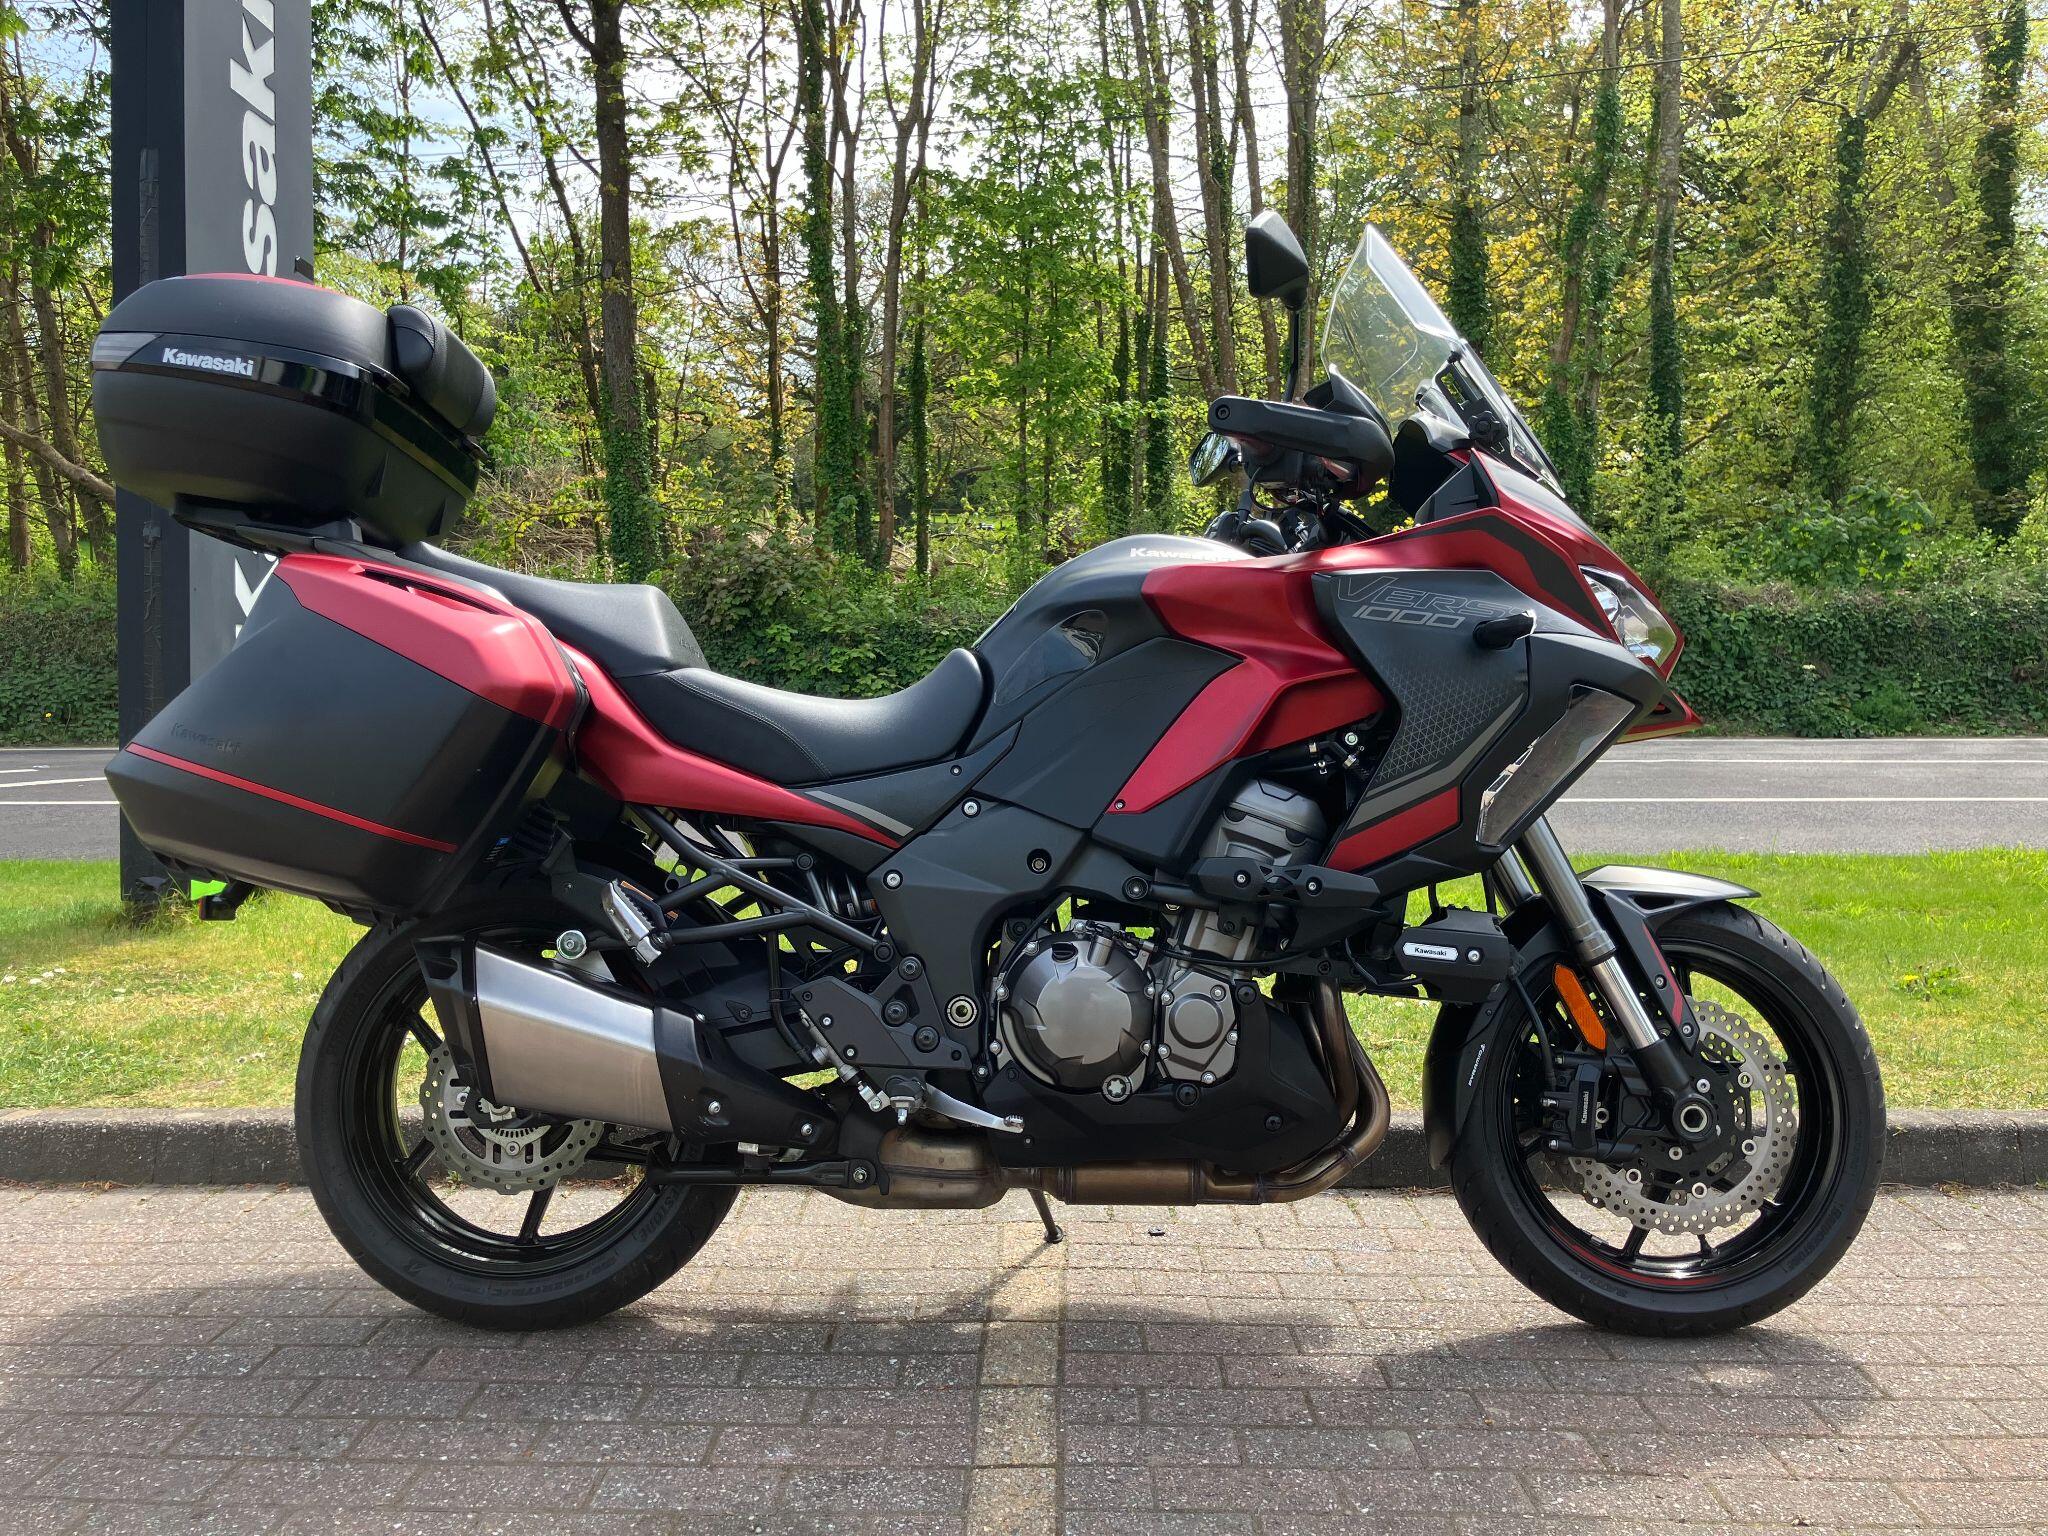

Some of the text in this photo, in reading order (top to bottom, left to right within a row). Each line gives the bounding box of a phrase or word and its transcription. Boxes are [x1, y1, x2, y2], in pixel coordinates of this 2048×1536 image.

[162, 347, 254, 377] Kawasaki
[1337, 576, 1526, 619] VERS
[1352, 605, 1465, 629] 1000
[1414, 946, 1447, 957] Kawasaki
[1580, 1091, 1590, 1124] Kawasaki
